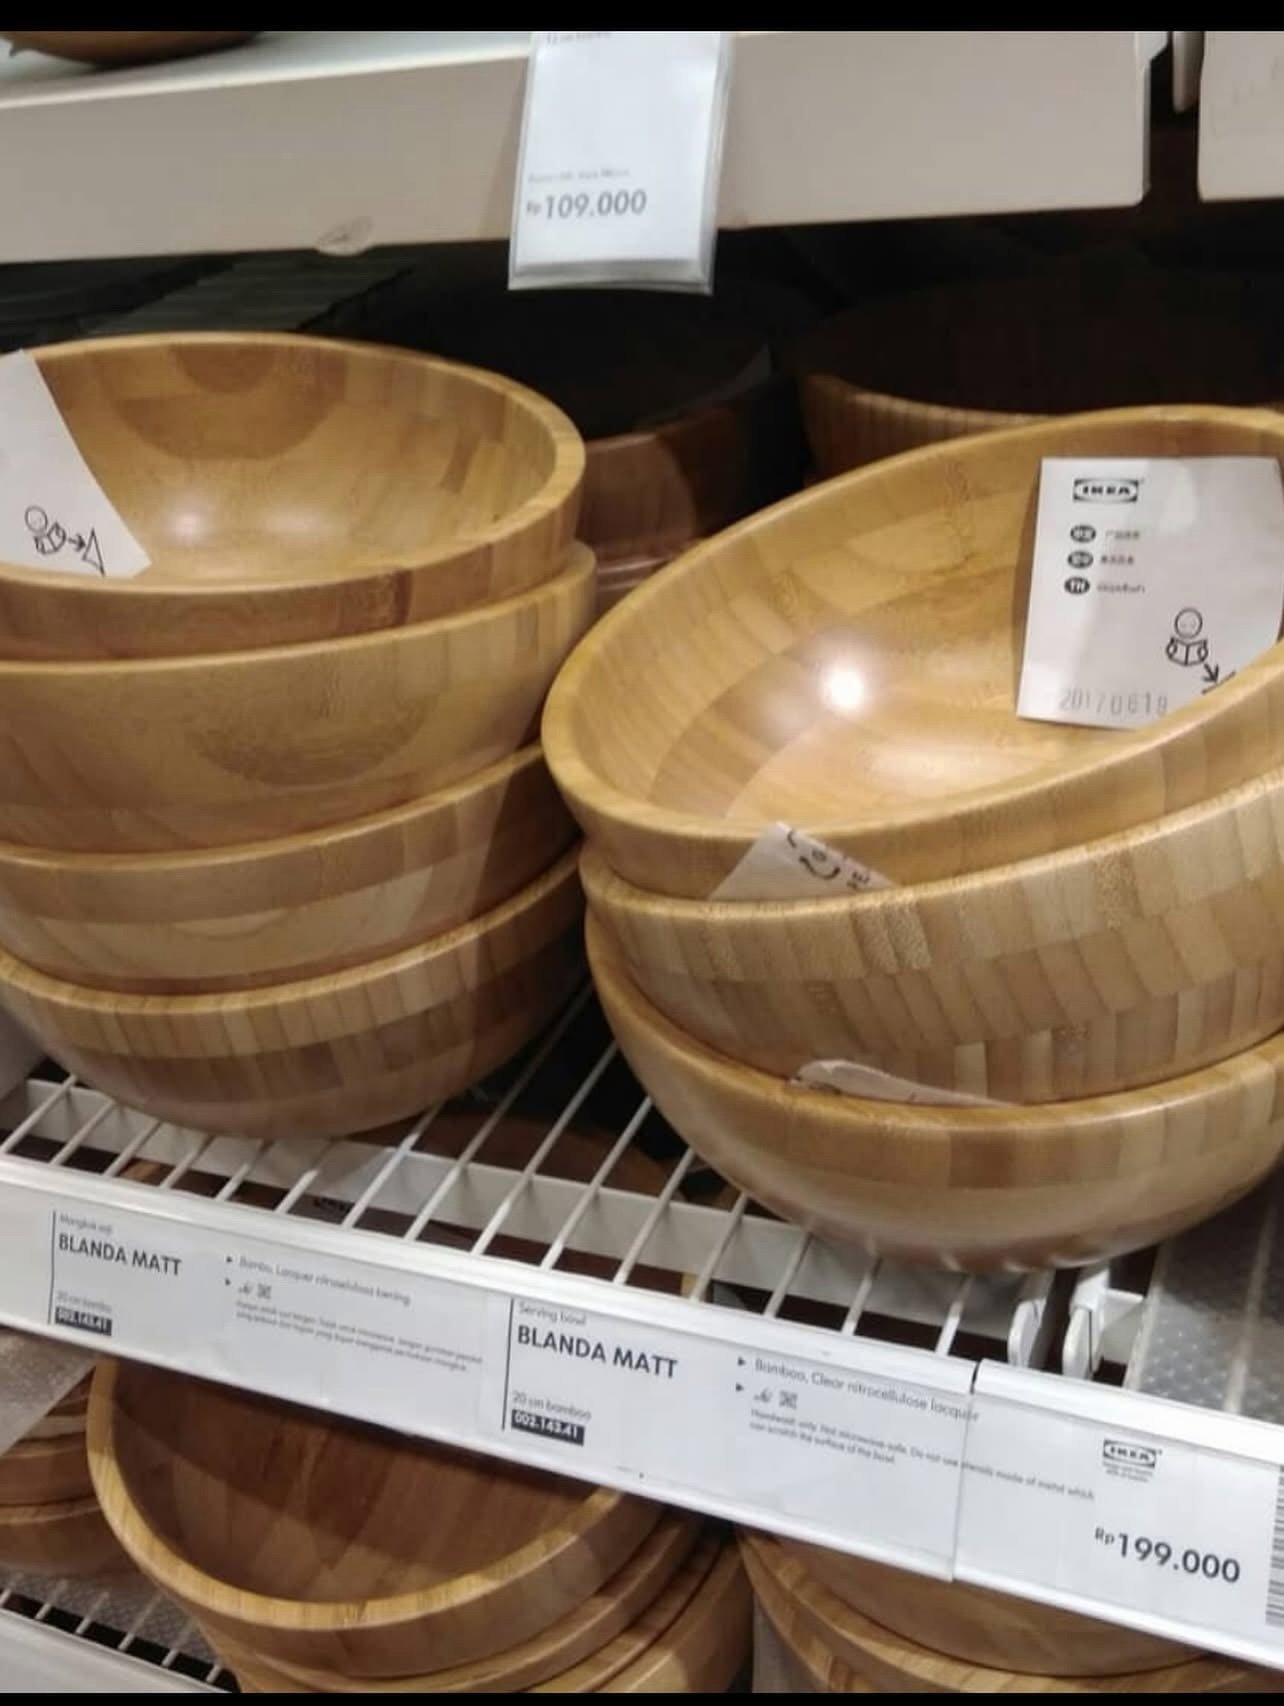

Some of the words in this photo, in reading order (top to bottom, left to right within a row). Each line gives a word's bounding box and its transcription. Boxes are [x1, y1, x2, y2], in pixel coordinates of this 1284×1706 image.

[59, 1232, 127, 1265] BLANDA
[132, 1249, 182, 1276] MATT
[519, 1301, 557, 1324] Serving
[560, 1309, 586, 1327] bowl
[518, 1325, 606, 1364] BLANDA
[613, 1347, 678, 1379] MATT
[512, 1389, 527, 1405] 20
